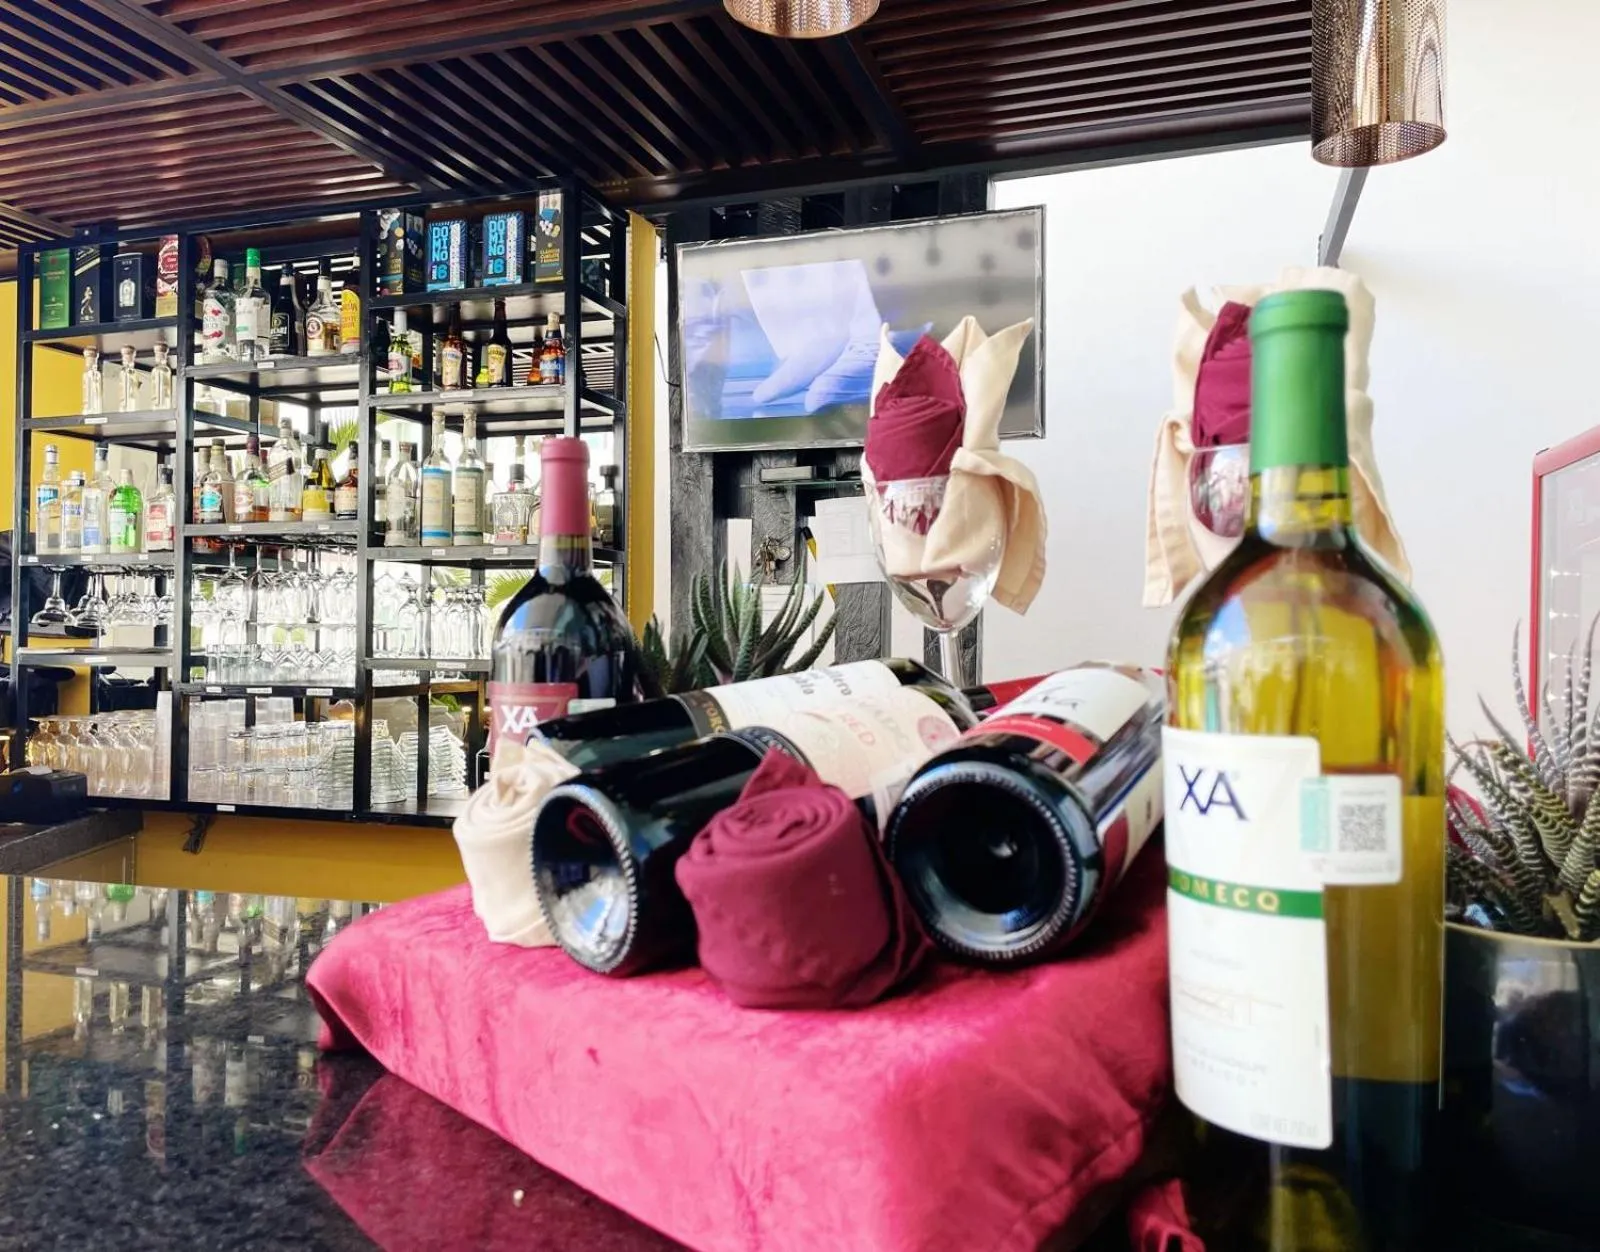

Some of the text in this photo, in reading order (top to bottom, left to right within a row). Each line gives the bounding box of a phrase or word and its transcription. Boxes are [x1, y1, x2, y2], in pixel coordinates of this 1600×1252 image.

[500, 705, 540, 734] XA
[1178, 763, 1250, 822] XA
[1177, 873, 1280, 913] OMECQ
